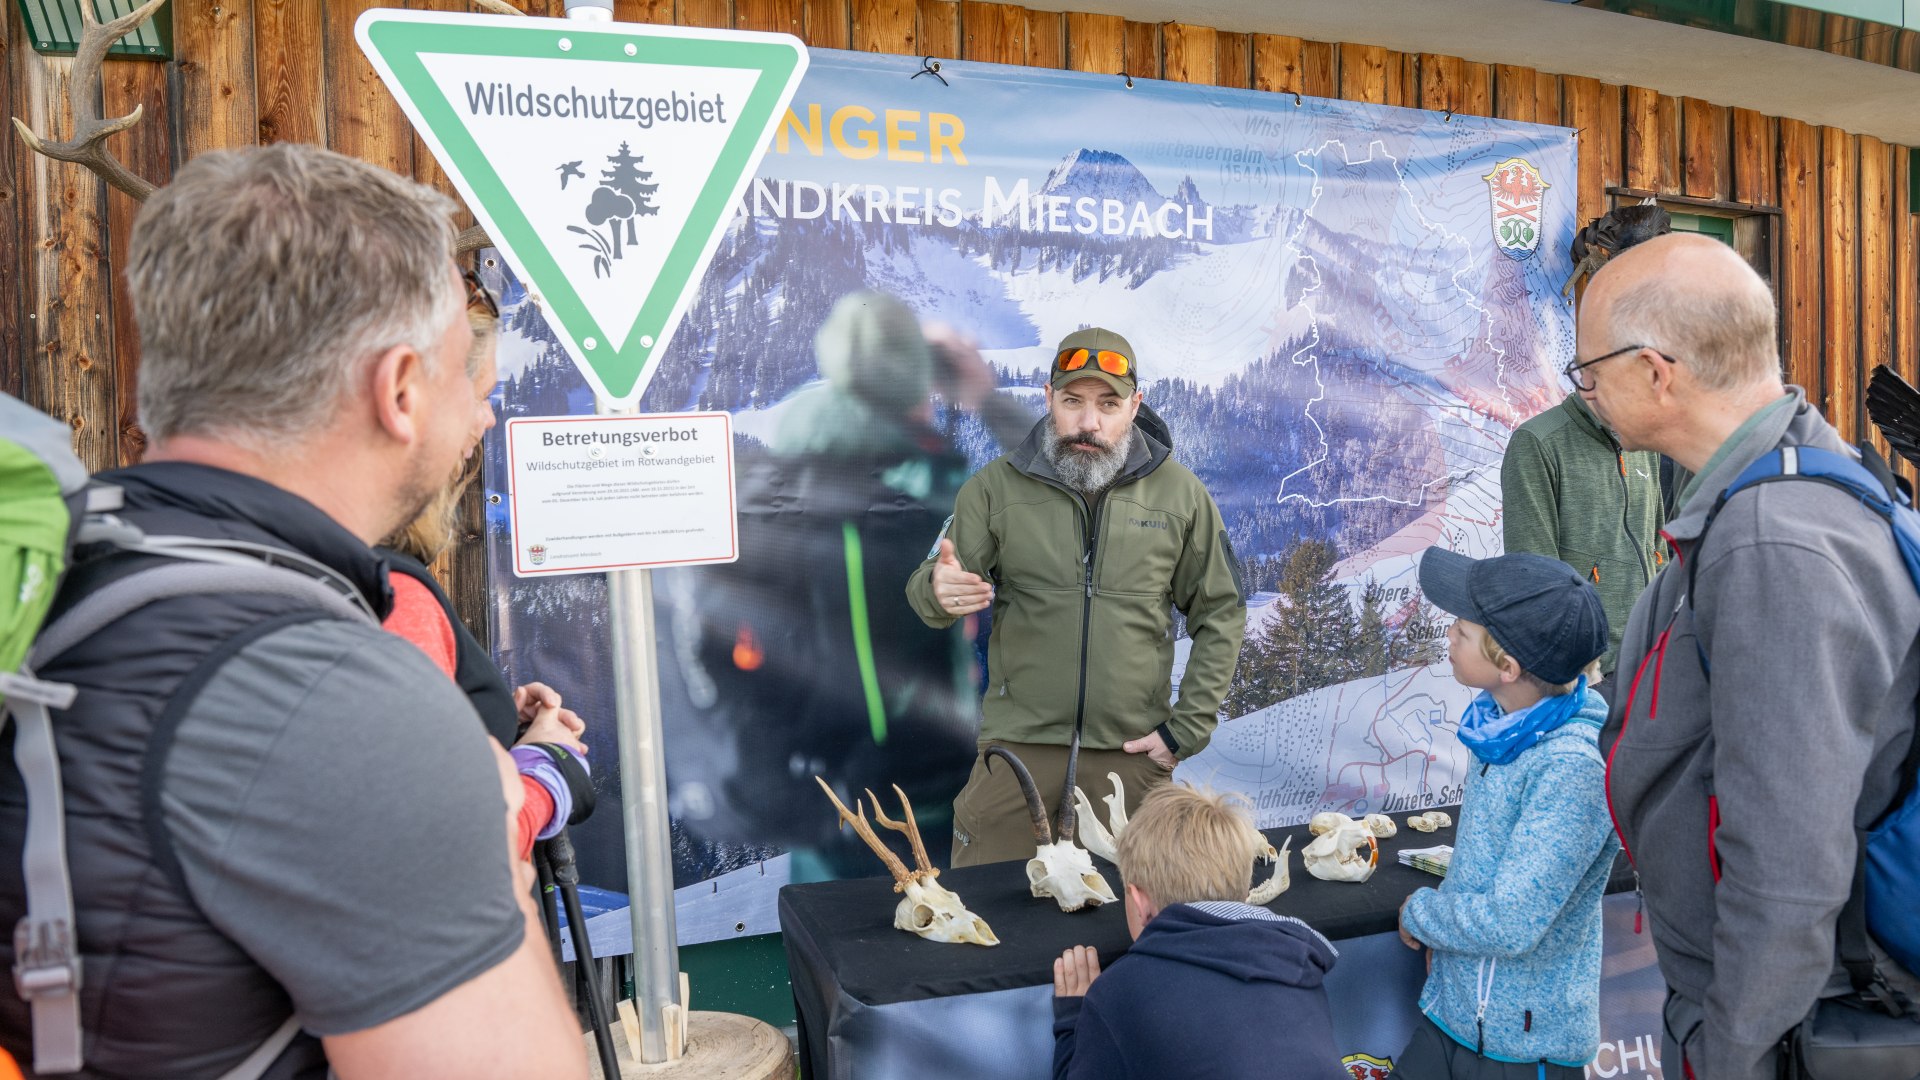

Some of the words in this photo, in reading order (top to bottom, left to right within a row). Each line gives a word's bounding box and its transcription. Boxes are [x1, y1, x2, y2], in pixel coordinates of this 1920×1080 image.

[464, 81, 727, 129] Wildschutzgebiet
[765, 102, 969, 166] NGER
[542, 427, 698, 448] Betretungsverbot
[526, 459, 619, 472] Wildschutzgebiet
[622, 459, 635, 467] im
[638, 454, 716, 467] Rotwandgebiet
[1382, 792, 1433, 812] Untere
[1584, 1034, 1662, 1080] CHU
